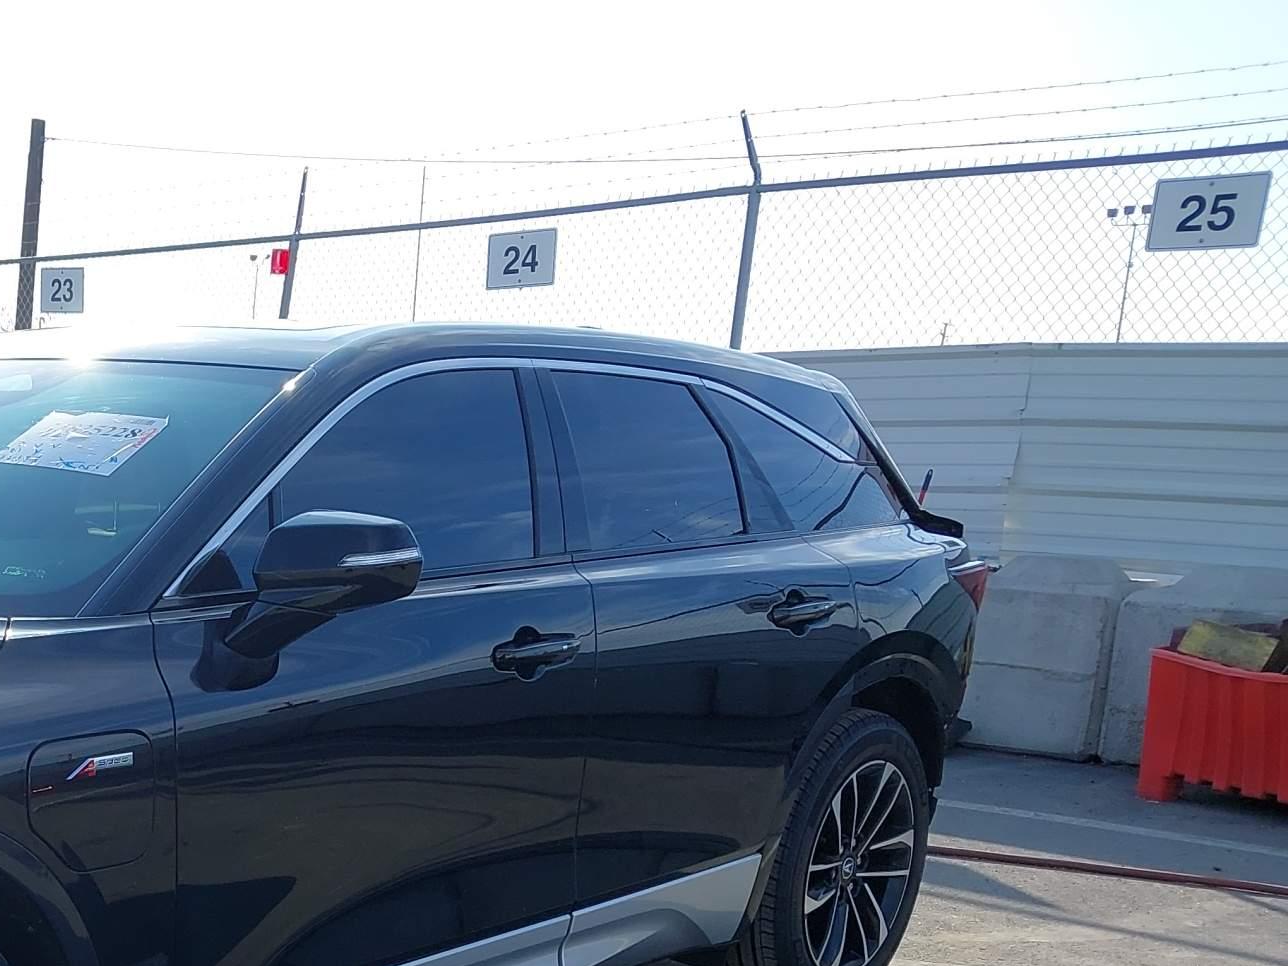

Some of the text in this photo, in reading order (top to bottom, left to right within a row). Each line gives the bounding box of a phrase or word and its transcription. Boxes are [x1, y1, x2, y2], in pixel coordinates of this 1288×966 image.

[1175, 192, 1239, 233] 25
[502, 244, 539, 276] 24
[50, 278, 74, 303] 23
